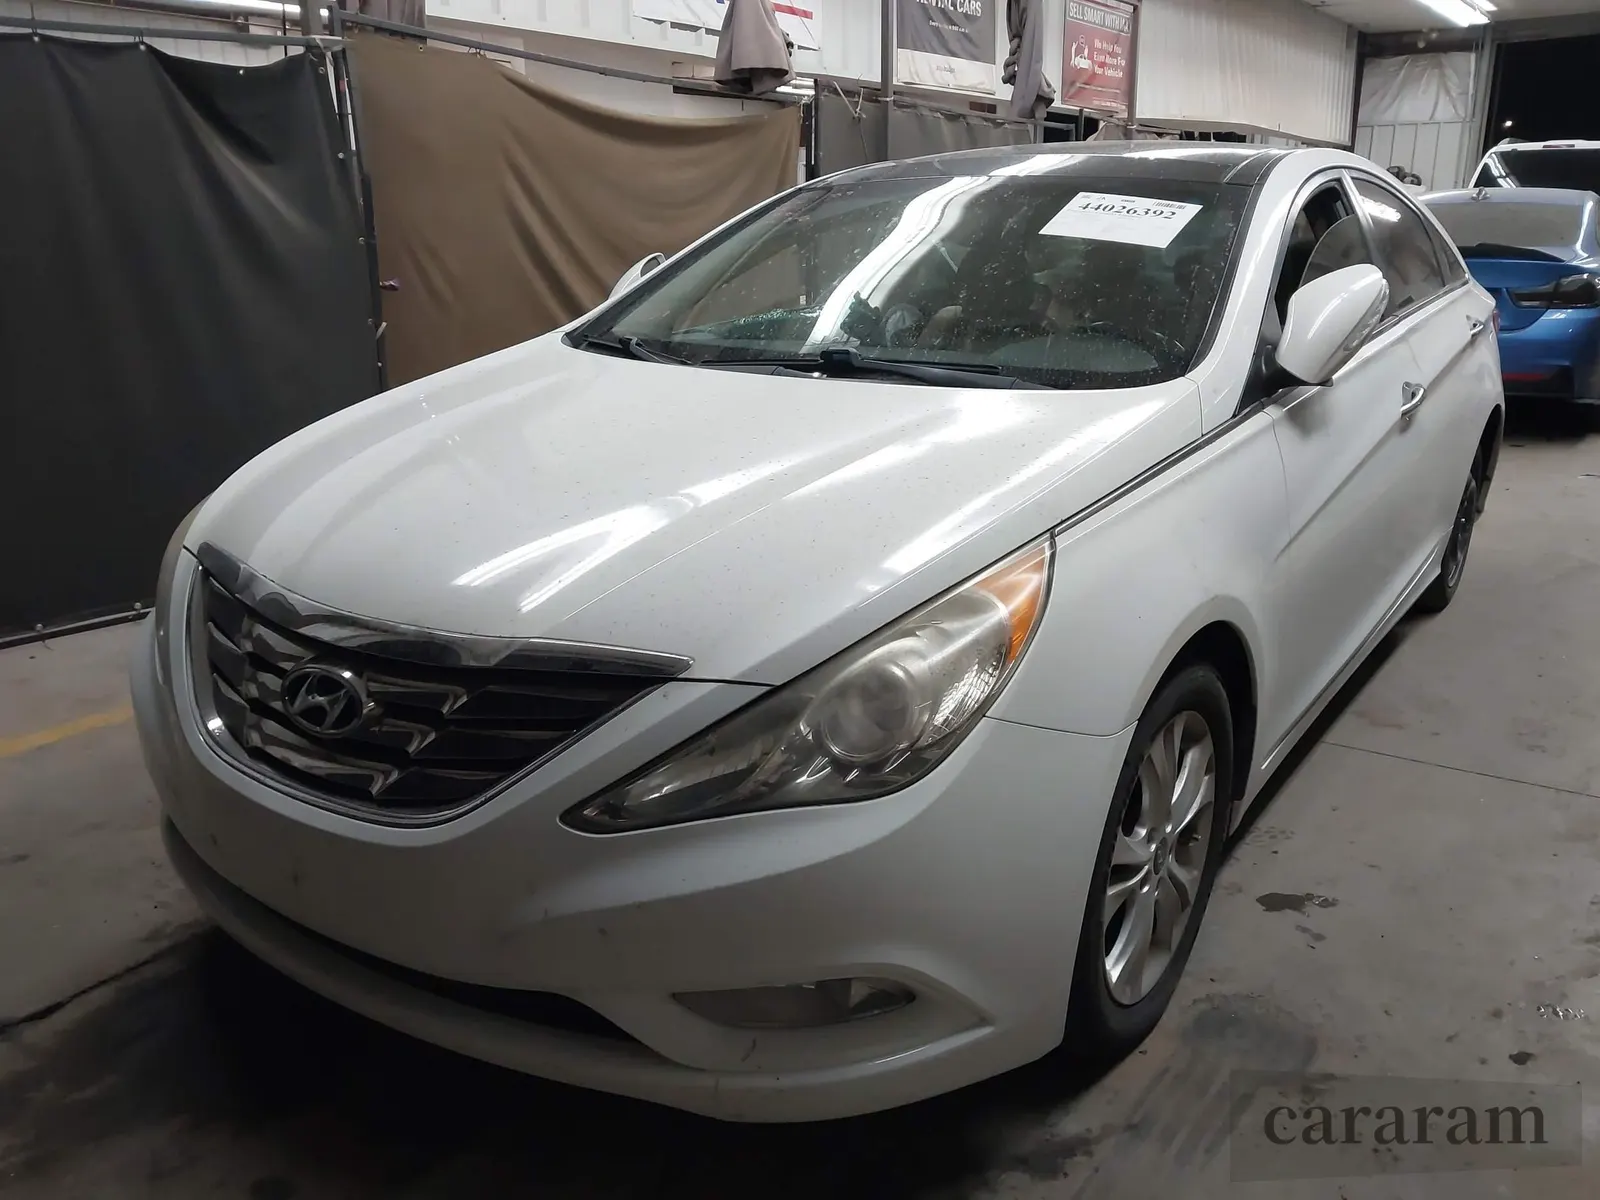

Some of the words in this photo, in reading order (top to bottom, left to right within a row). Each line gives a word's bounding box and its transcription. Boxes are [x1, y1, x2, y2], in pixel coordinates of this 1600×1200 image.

[916, 0, 954, 10] TAL
[956, 0, 982, 17] CARS
[1070, 2, 1083, 19] SELL
[1083, 6, 1104, 25] SMART
[1104, 11, 1120, 30] WITH
[1078, 202, 1177, 220] 44026392
